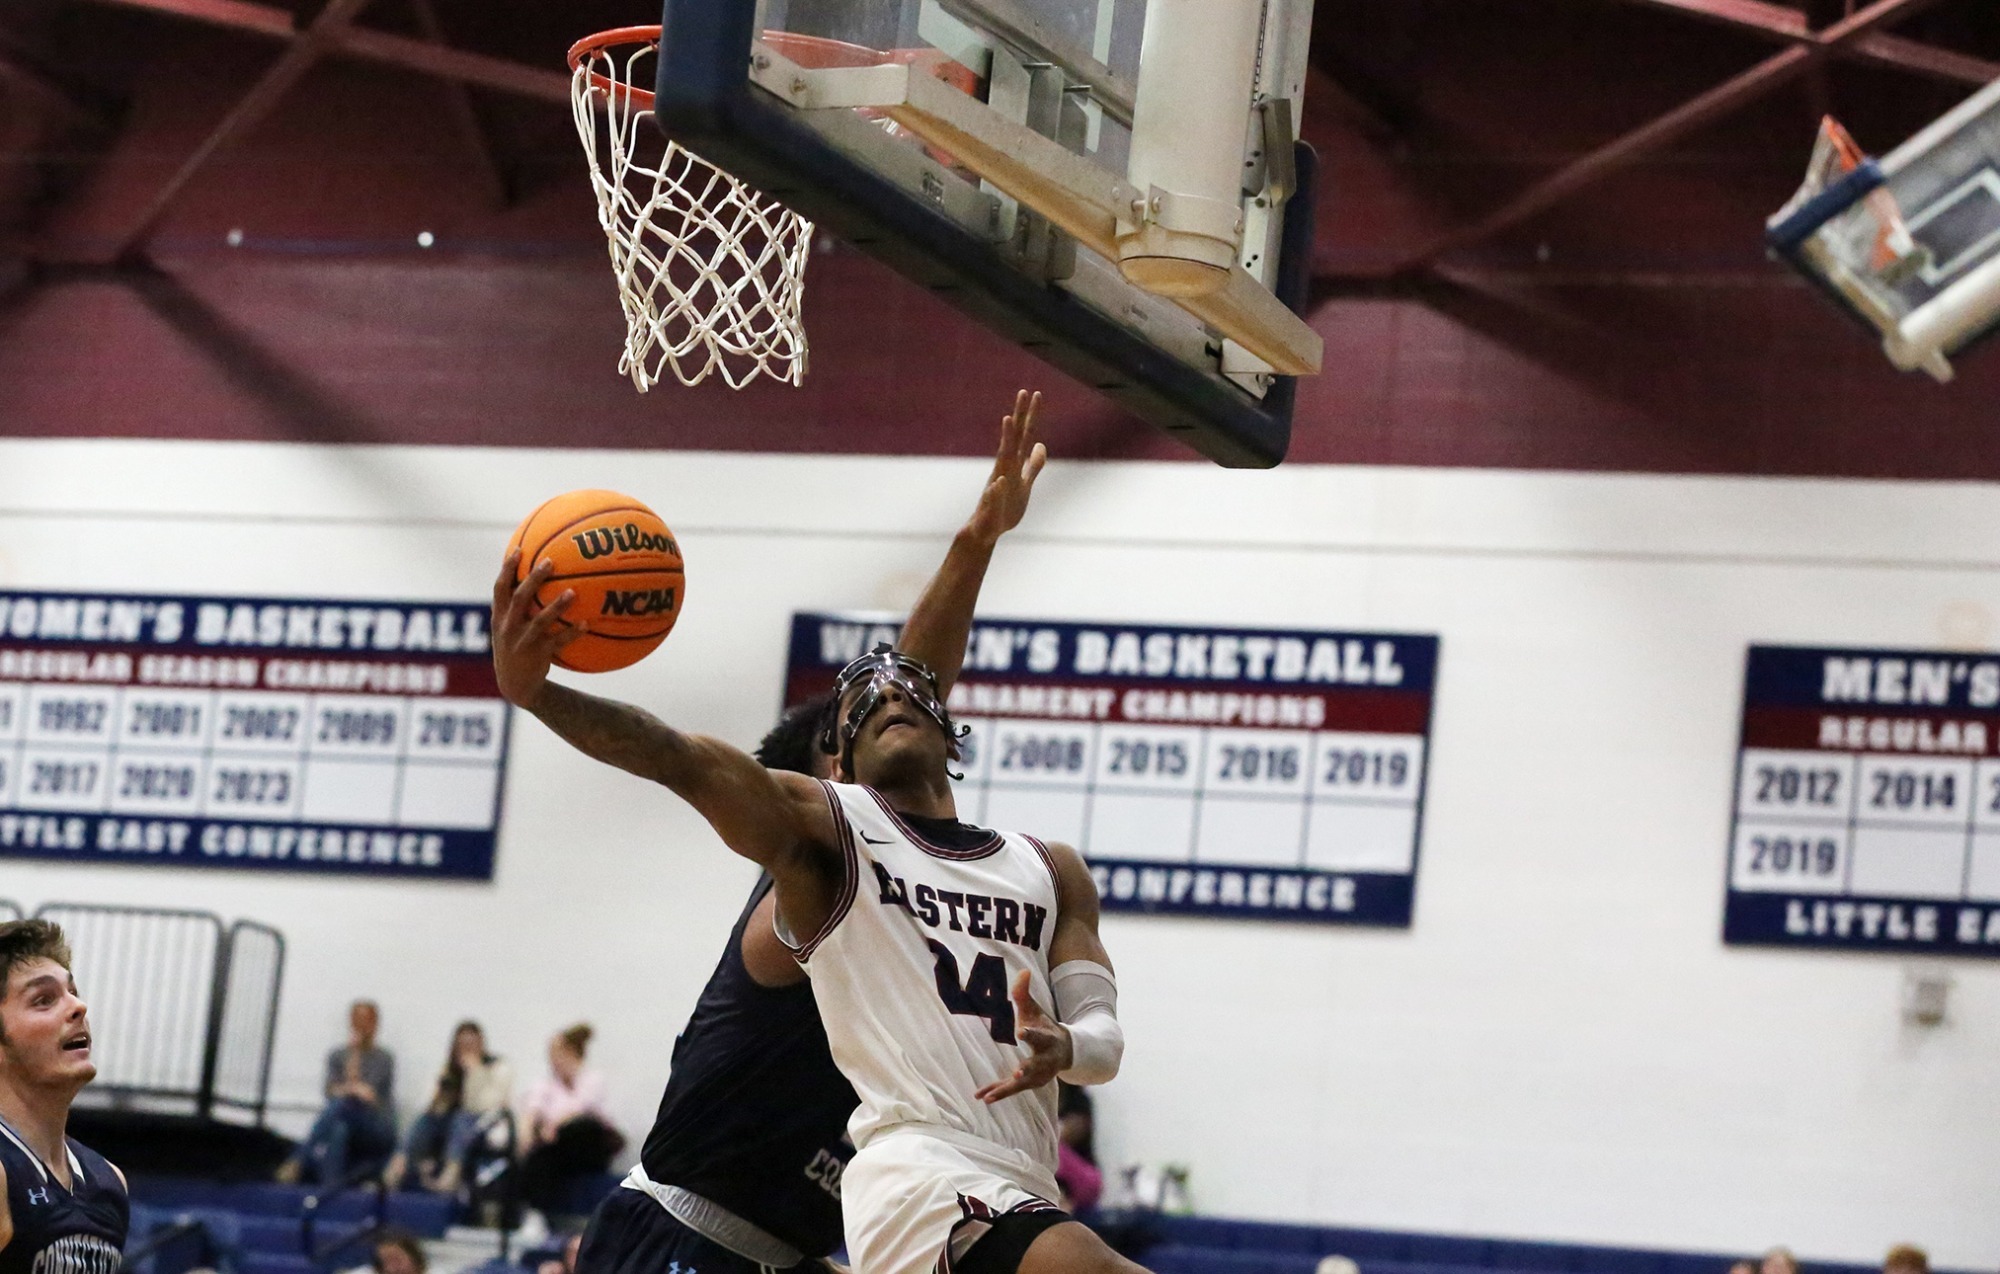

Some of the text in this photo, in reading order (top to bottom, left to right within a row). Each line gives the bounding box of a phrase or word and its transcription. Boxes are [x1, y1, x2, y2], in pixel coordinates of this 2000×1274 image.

[571, 523, 681, 560] Wilson
[601, 587, 676, 615] NCAA
[0, 597, 490, 653] OMEN'S BASKETBALL
[138, 654, 259, 688] SEASON
[264, 659, 448, 693] CHAMPIONS
[1074, 630, 1402, 685] BASKETBALL
[1822, 658, 2000, 707] MEN'S
[129, 703, 202, 736] 2001
[221, 706, 299, 740] 2002
[317, 709, 397, 743] 2009
[417, 712, 492, 747] 2015
[1121, 689, 1326, 727] CHAMPIONS
[1819, 716, 1988, 754] REGULAR
[31, 761, 98, 794] 2017
[119, 765, 195, 798] 2020
[212, 768, 292, 803] 2023
[1000, 736, 1084, 770] 2008
[1108, 739, 1188, 776] 2015
[1218, 744, 1299, 780] 2016
[1325, 748, 1409, 785] 2019
[1756, 766, 1841, 804] 2012
[1871, 770, 1956, 809] 2014
[0, 815, 444, 867] TTLE EAST CONFERENCE
[1750, 836, 1837, 877] 2019
[871, 860, 1047, 951] EASTERN
[1090, 866, 1356, 912] CONFERENCE
[1785, 902, 2000, 945] LITTLE EA
